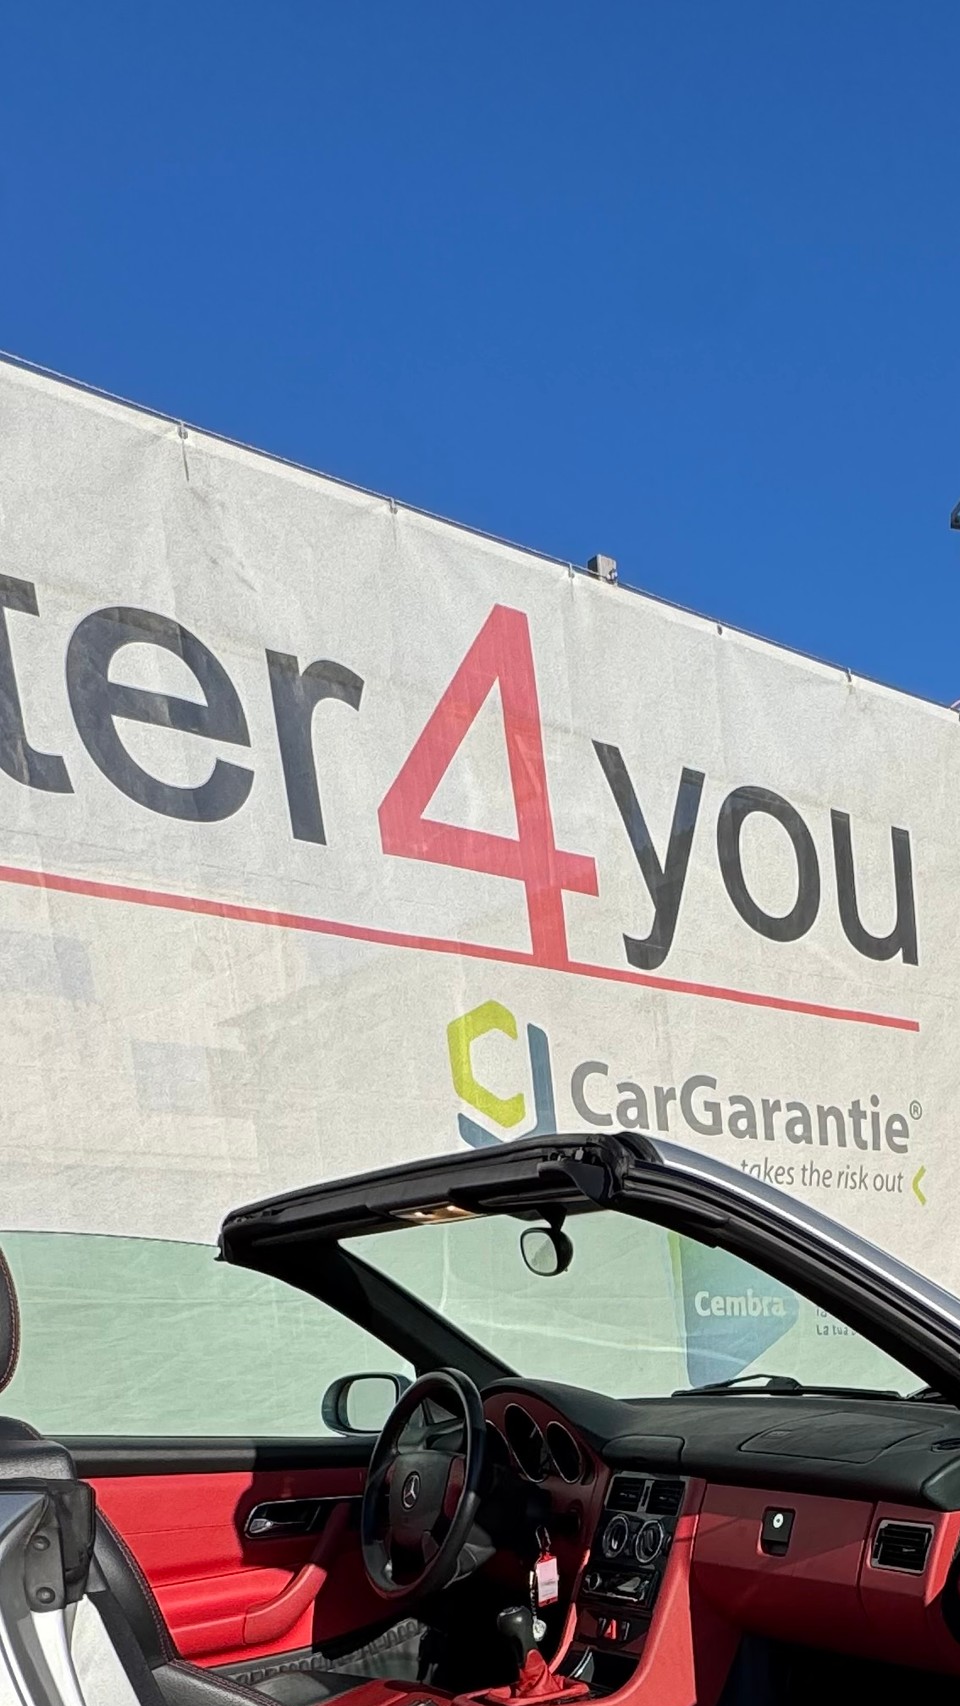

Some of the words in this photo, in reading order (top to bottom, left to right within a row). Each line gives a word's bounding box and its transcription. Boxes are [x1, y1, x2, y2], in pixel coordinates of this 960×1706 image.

[801, 1160, 833, 1188] the
[837, 1165, 868, 1190] risk
[873, 1172, 904, 1193] out
[694, 1288, 787, 1317] Cembra
[816, 1324, 829, 1336] La
